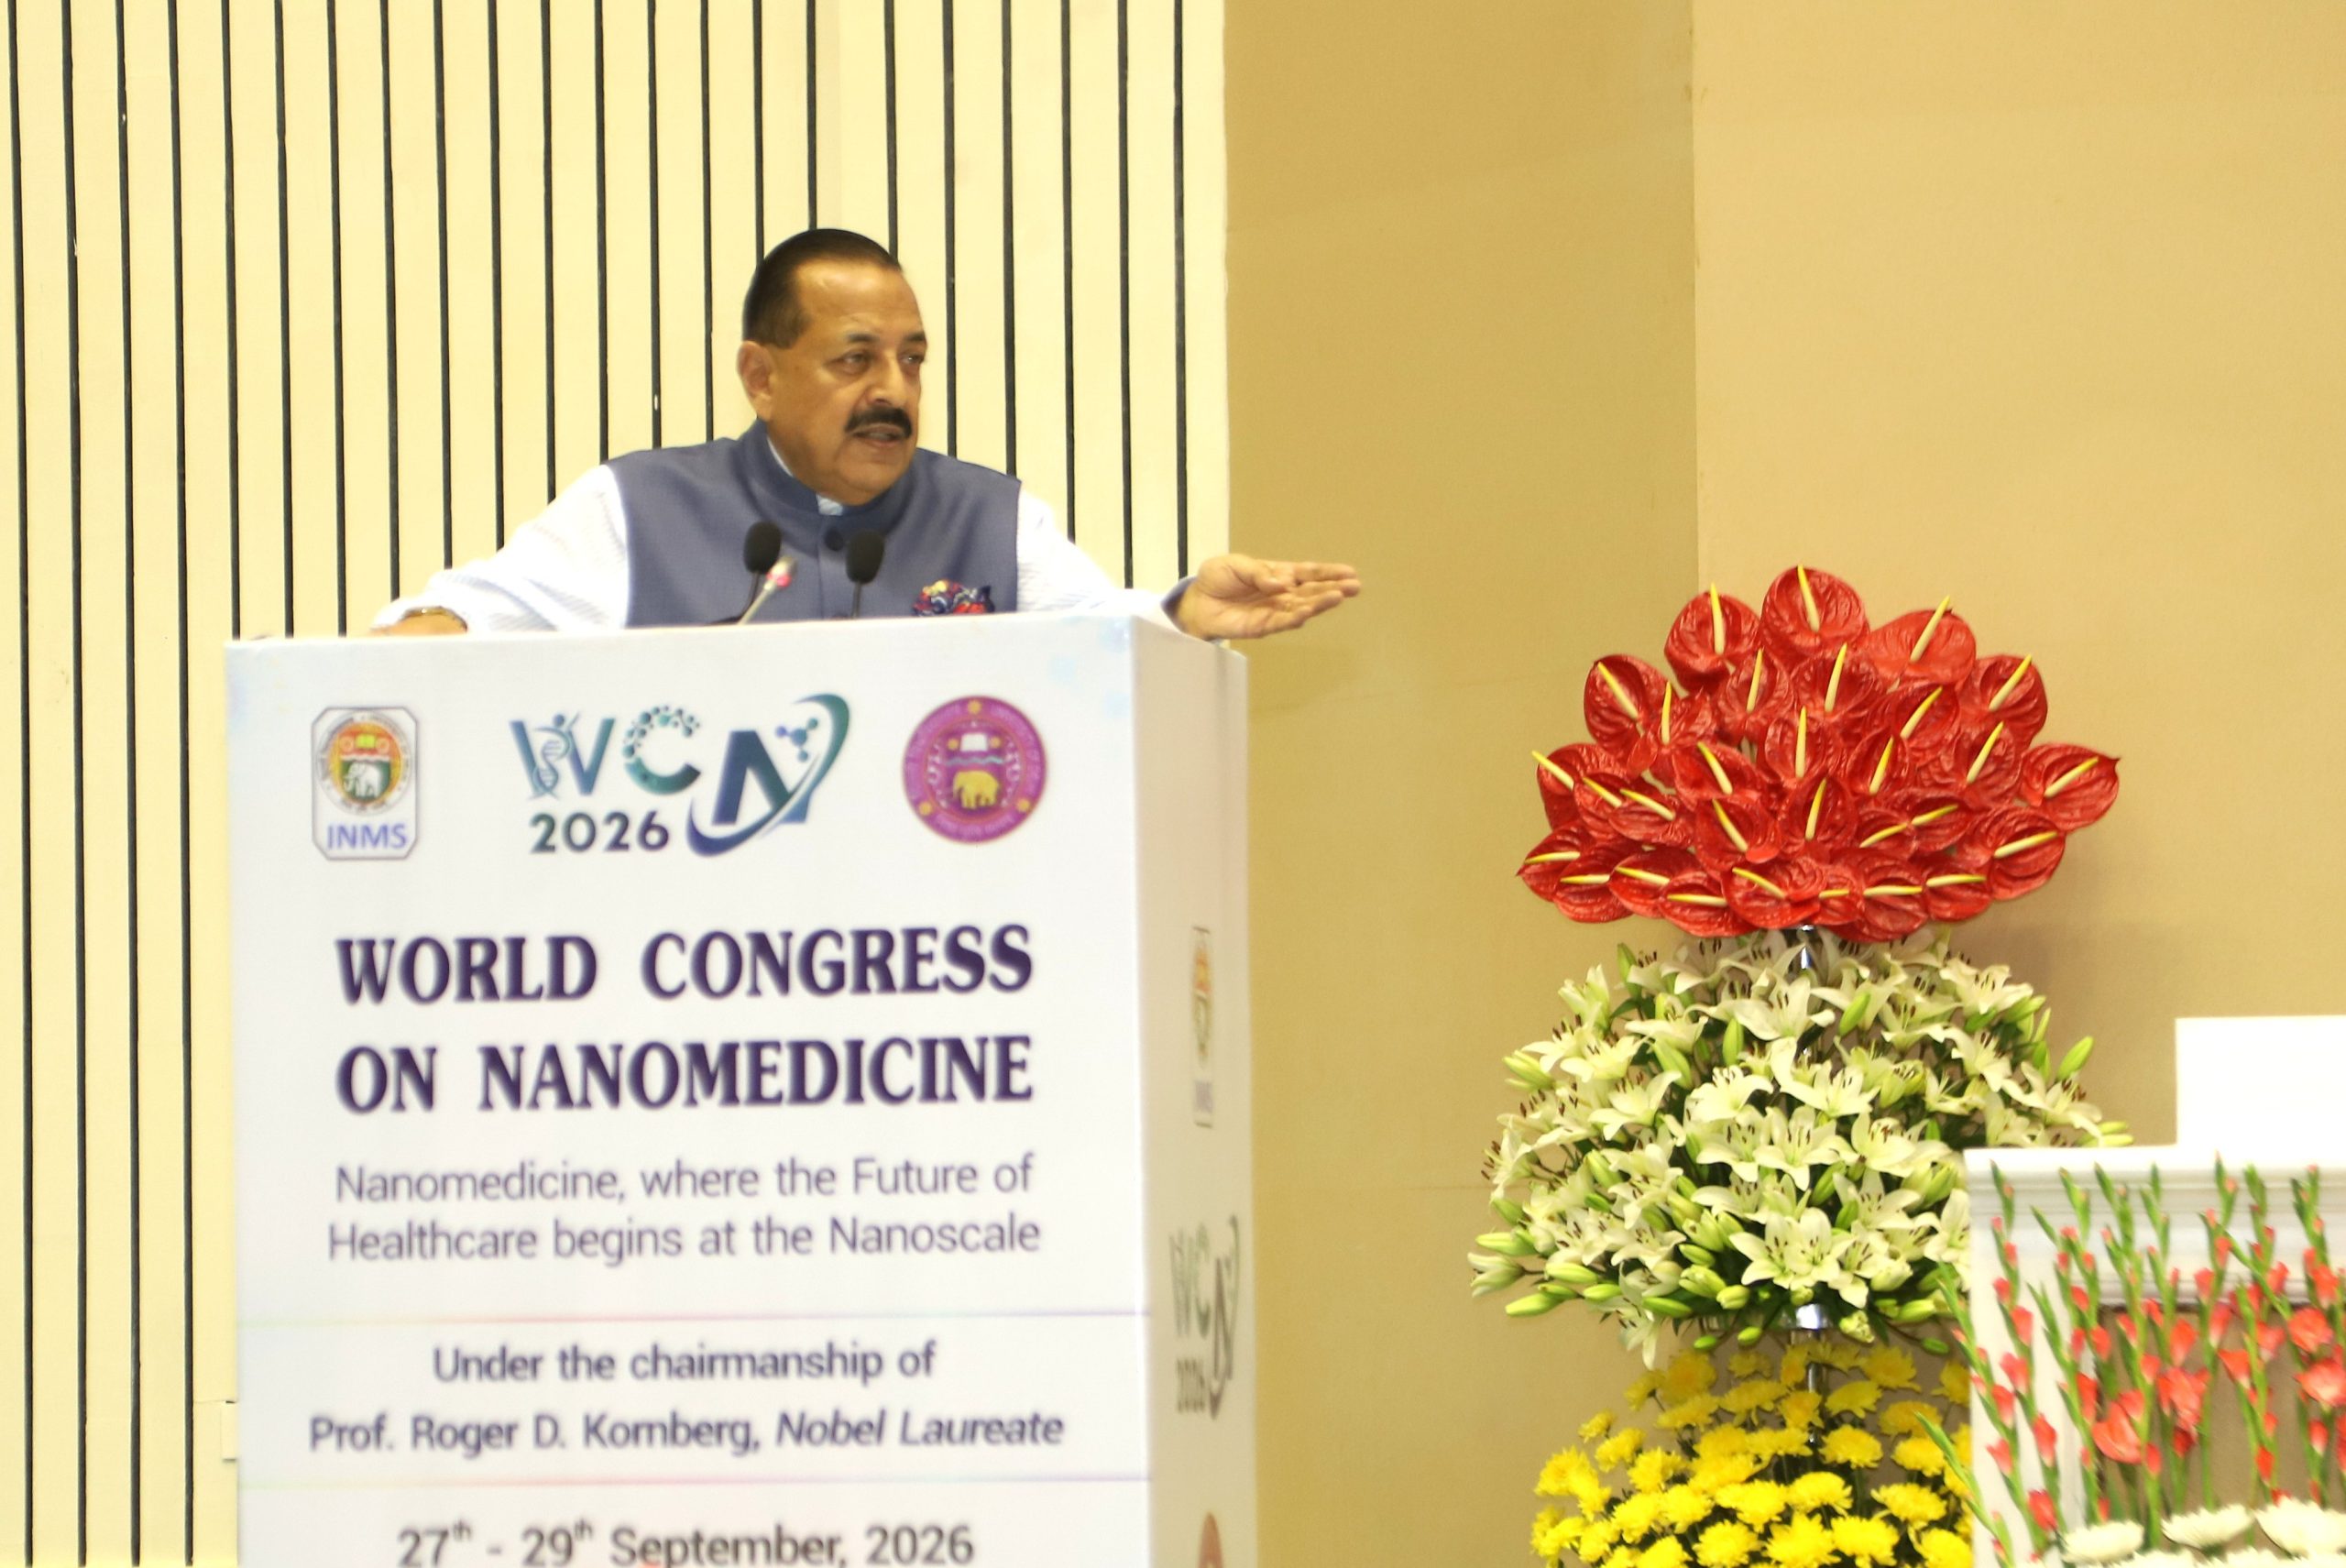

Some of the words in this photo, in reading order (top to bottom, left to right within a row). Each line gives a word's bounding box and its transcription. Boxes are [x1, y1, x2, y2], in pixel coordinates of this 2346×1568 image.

[326, 823, 408, 850] INMS
[529, 810, 671, 854] 2026
[334, 934, 598, 1006] WORLD
[641, 923, 1034, 1002] CONGRESS
[335, 1045, 439, 1115] ON
[478, 1034, 1035, 1112] NANOMEDICINE
[336, 1160, 626, 1205] Nanomedicine,
[641, 1158, 760, 1196] where
[776, 1157, 837, 1196] the
[854, 1157, 978, 1195] Future
[993, 1152, 1035, 1193] of
[329, 1221, 538, 1260] Healthcare
[554, 1218, 683, 1268] begins
[699, 1221, 736, 1255] at
[752, 1216, 813, 1255] the
[829, 1213, 1041, 1255] Nanoscale
[433, 1343, 543, 1383] Under
[558, 1343, 616, 1381] the
[630, 1339, 884, 1387] chairmanship
[898, 1339, 937, 1378] of
[310, 1412, 394, 1451] Prof.
[411, 1414, 519, 1459] Roger
[533, 1412, 565, 1449] D.
[583, 1409, 761, 1457] Kornberg,
[775, 1408, 887, 1446] Nobel
[899, 1409, 1065, 1446] Laureate
[398, 1519, 473, 1568] 27th
[521, 1518, 594, 1568] 29th
[610, 1522, 848, 1568] September,
[866, 1523, 975, 1566] 2026
